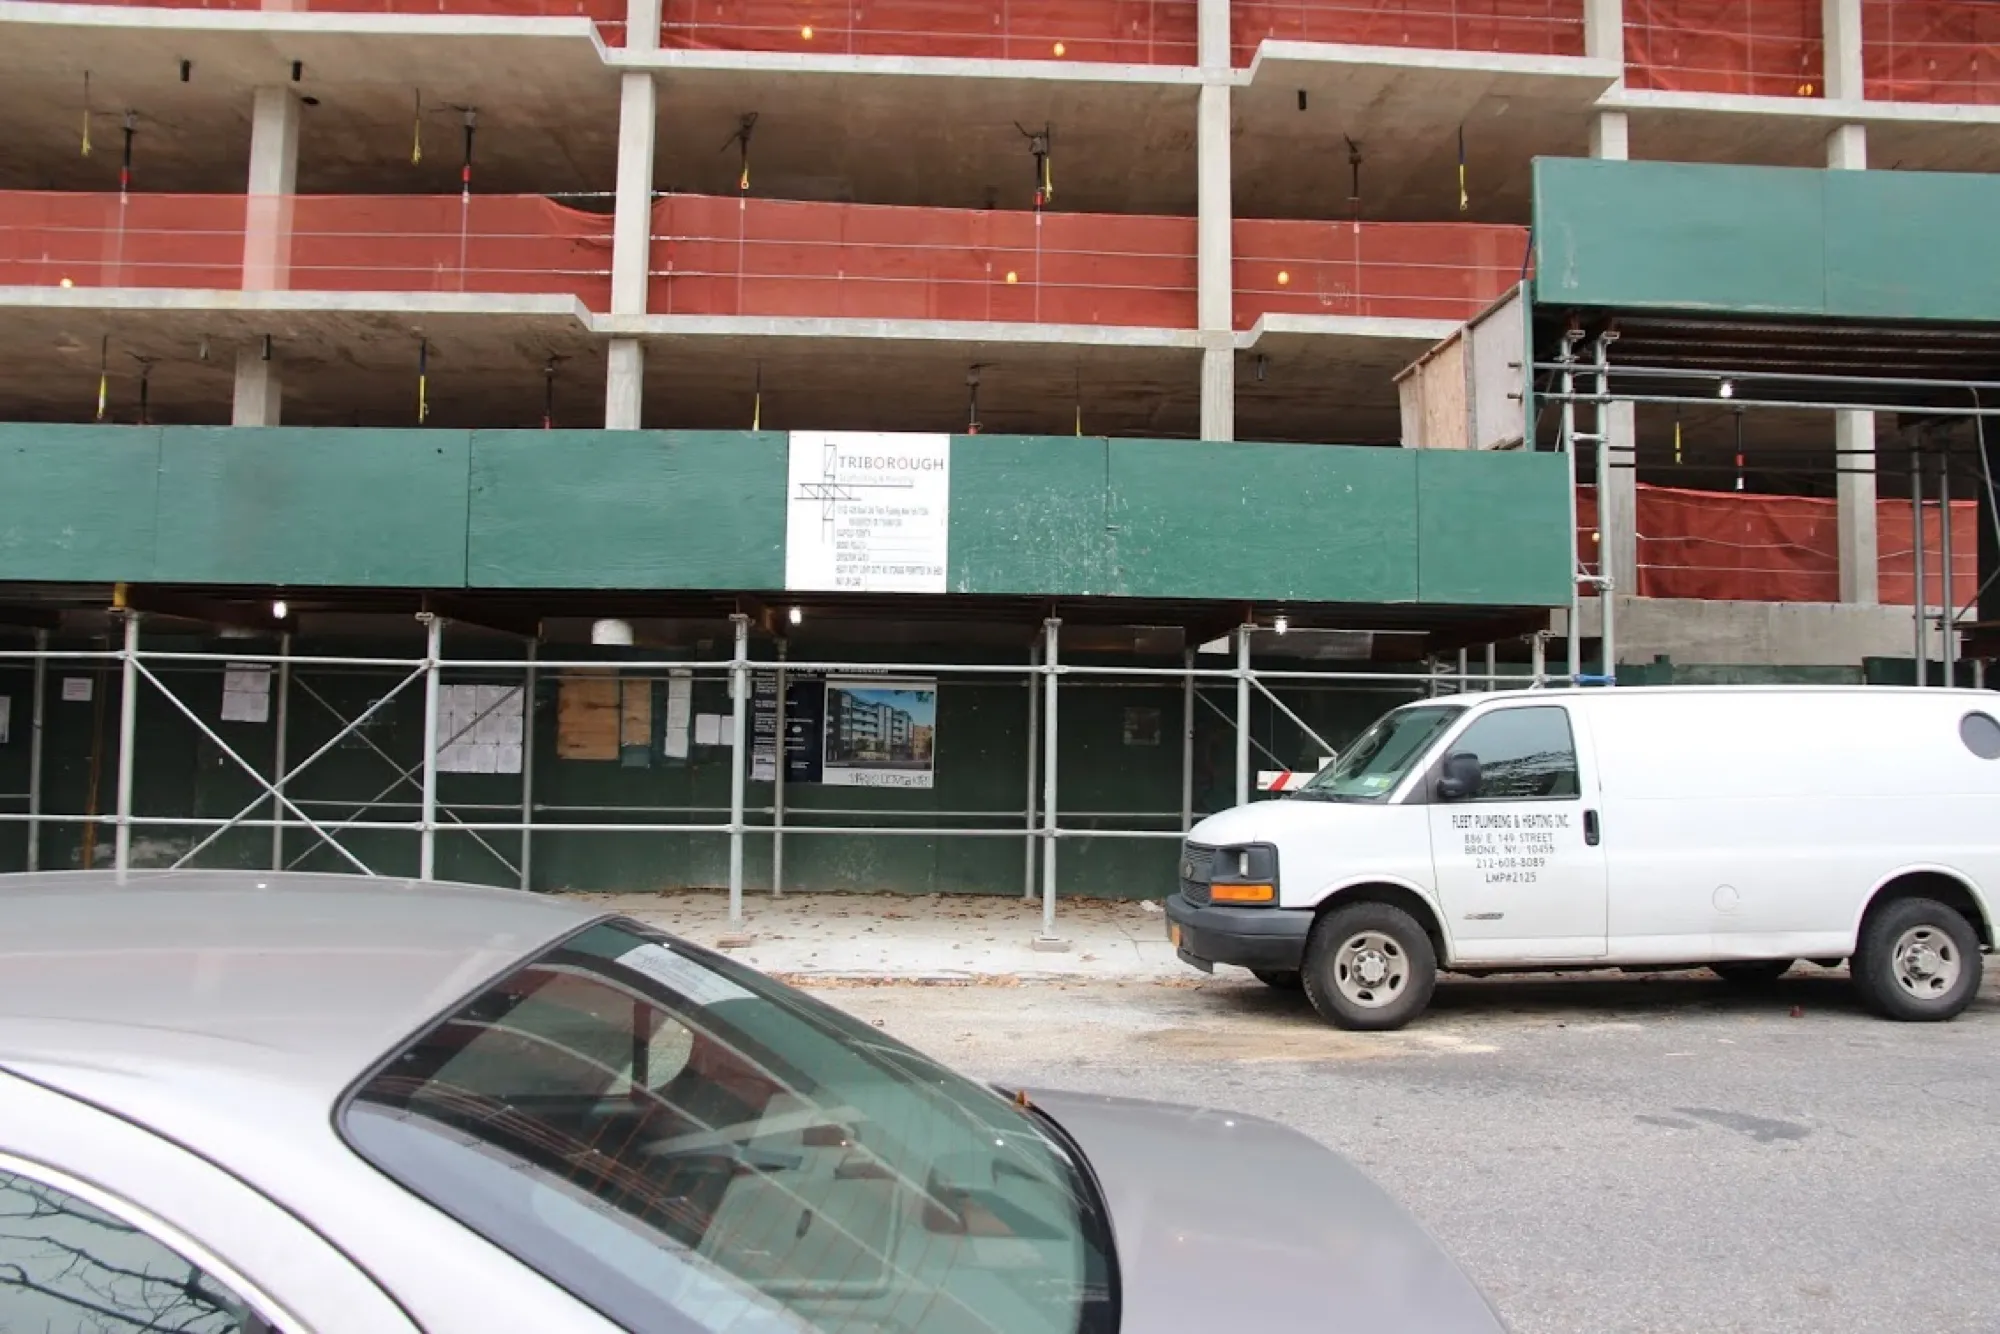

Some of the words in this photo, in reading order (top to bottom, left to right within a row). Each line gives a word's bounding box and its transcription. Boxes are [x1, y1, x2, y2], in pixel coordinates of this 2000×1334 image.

[838, 456, 944, 471] TRIBOROUGH
[1452, 814, 1472, 829] FLEET
[1475, 814, 1512, 828] PLUMBING
[1522, 814, 1553, 828] HEATING
[1498, 832, 1515, 843] 149
[1519, 832, 1553, 843] STREET
[1476, 857, 1545, 869] 212-608-8089
[1485, 872, 1537, 884] LMP#2125
